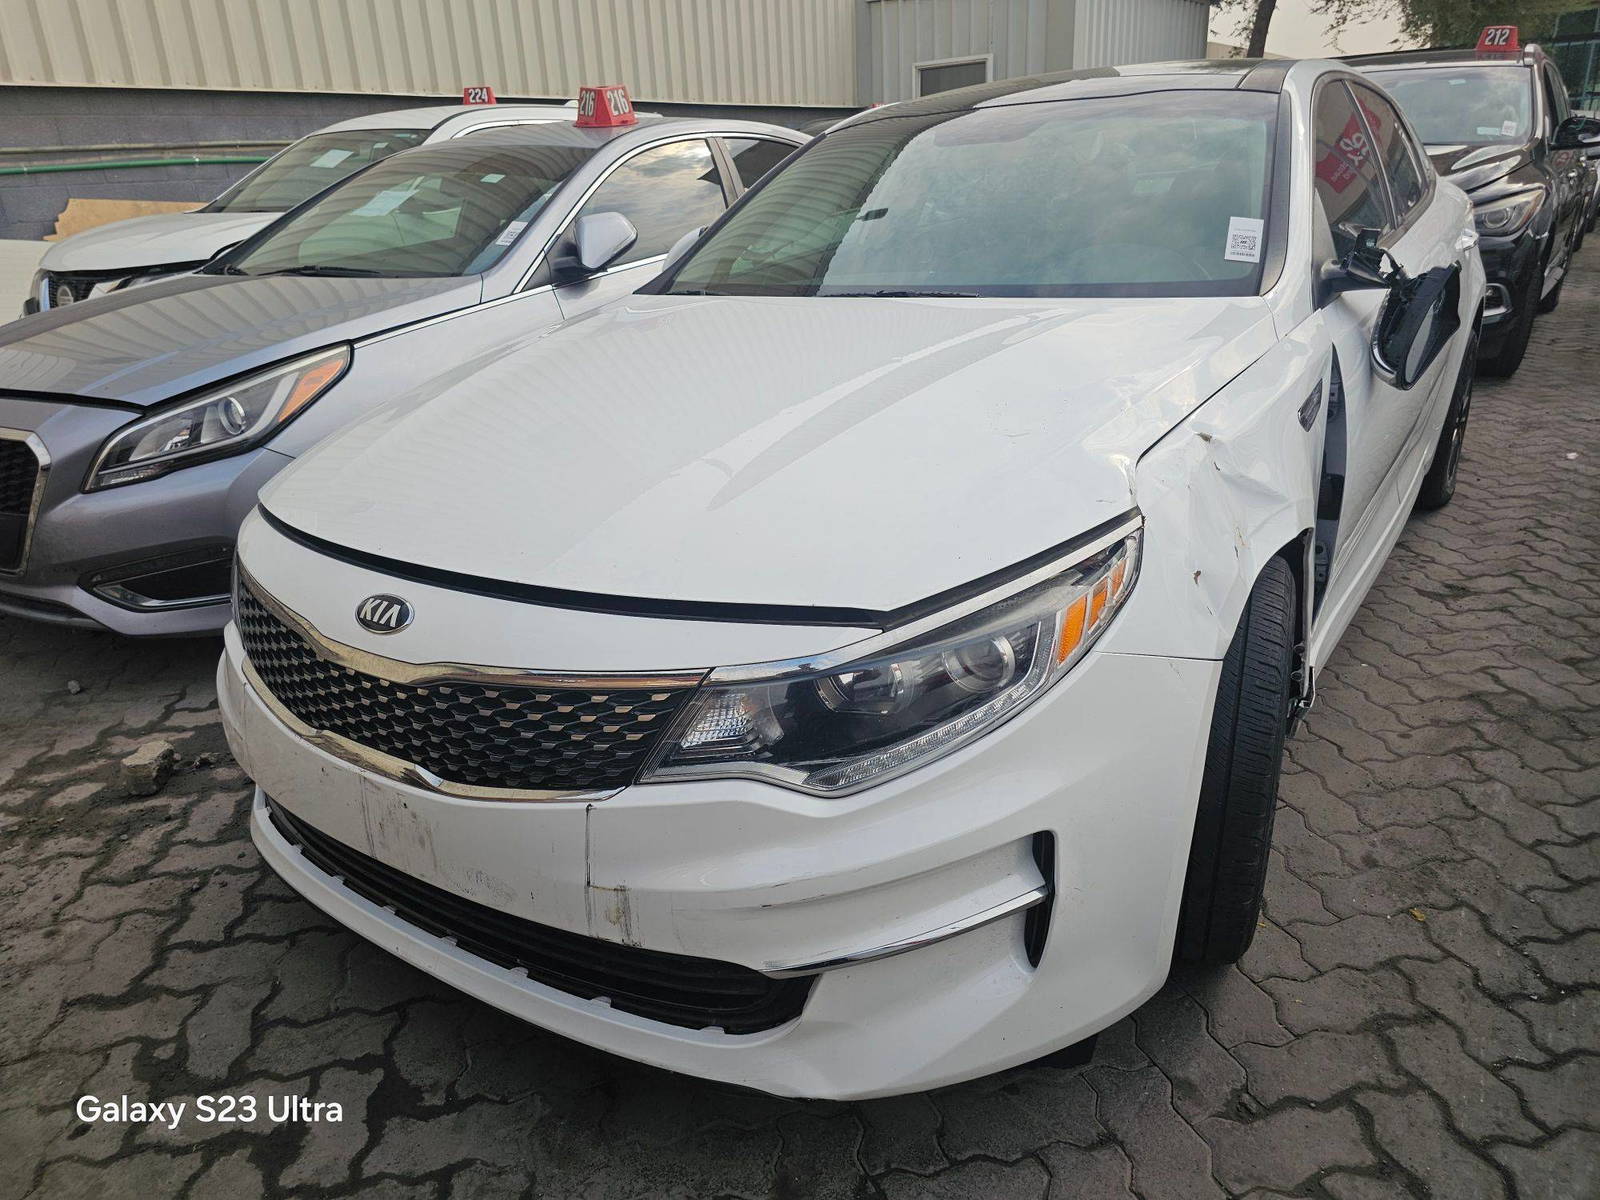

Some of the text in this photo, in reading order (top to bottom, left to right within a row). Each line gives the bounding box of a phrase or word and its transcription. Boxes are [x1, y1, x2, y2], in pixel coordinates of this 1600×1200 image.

[1484, 28, 1510, 46] 212
[468, 88, 488, 103] 224
[579, 92, 594, 116] 216
[607, 89, 630, 116] 216
[360, 597, 401, 628] KIA
